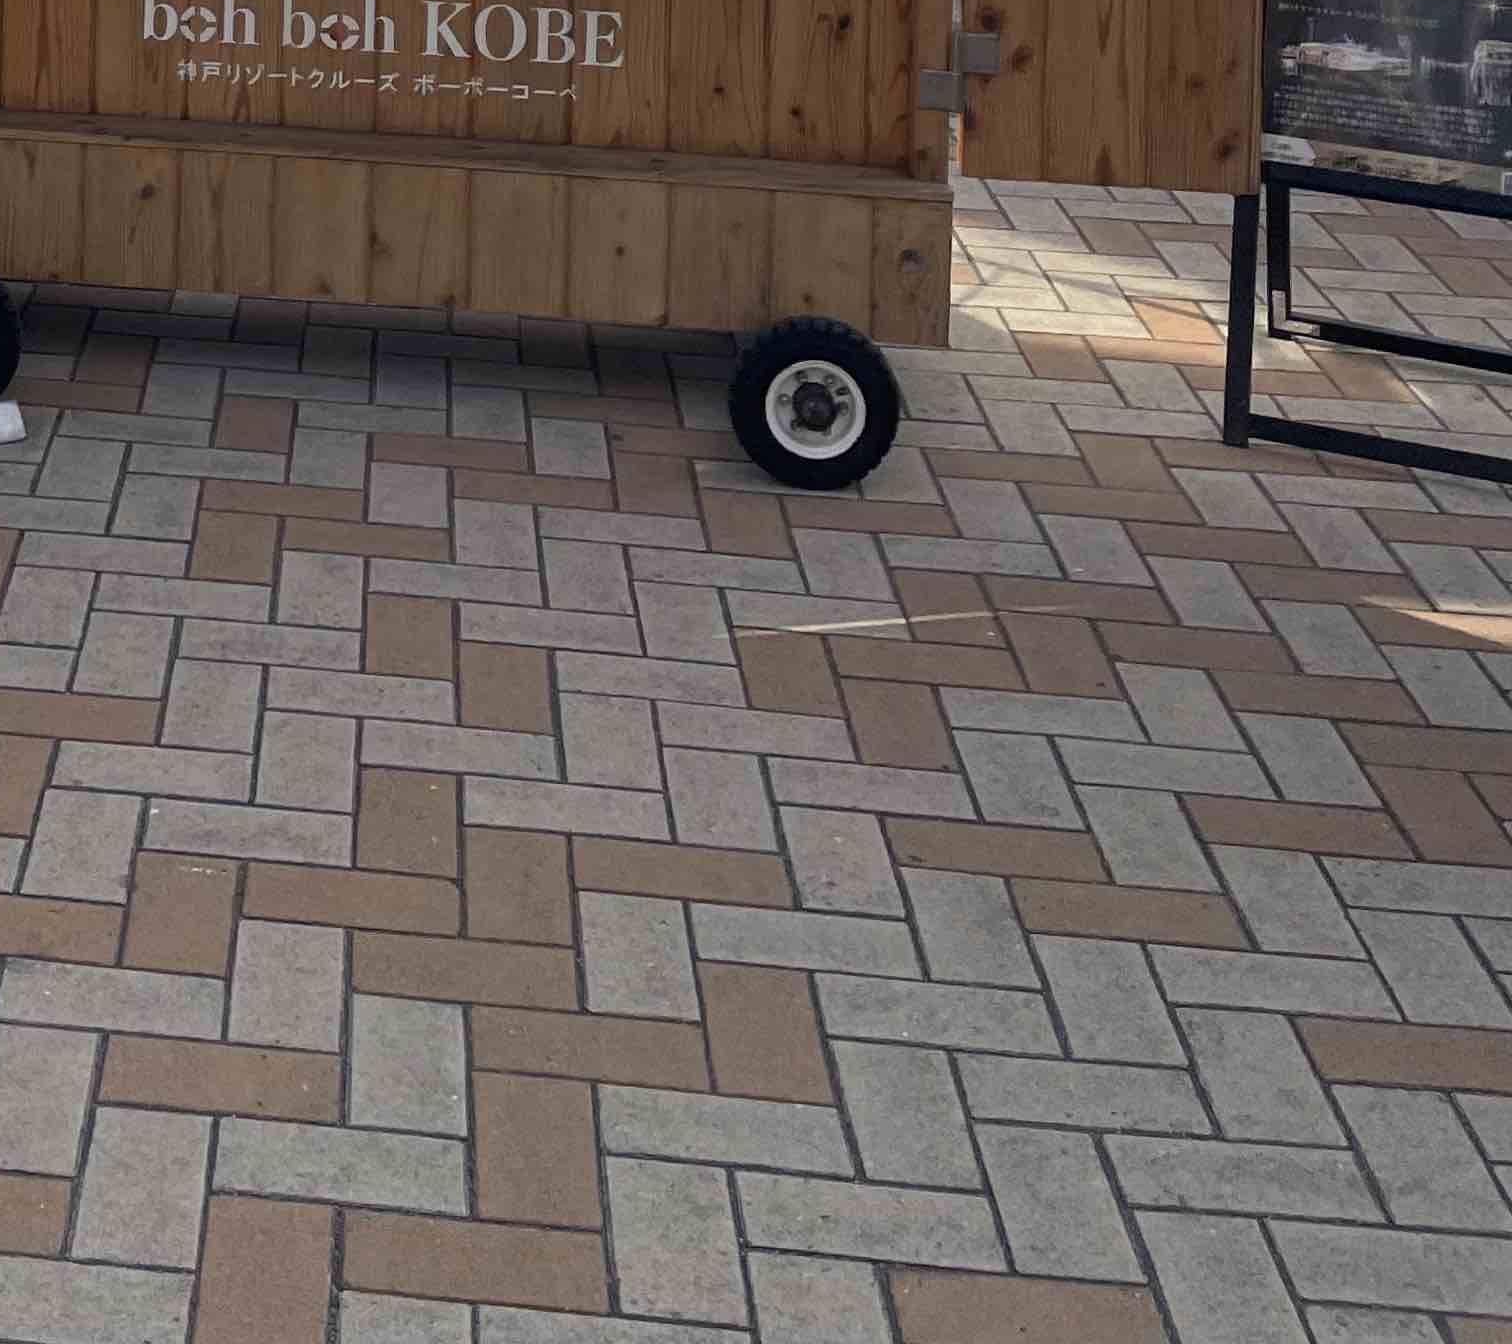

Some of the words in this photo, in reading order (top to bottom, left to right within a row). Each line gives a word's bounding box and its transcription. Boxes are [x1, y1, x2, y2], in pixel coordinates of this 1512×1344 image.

[419, 0, 626, 69] KOBE
[176, 58, 401, 94] 神戸リゾートクルーズ
